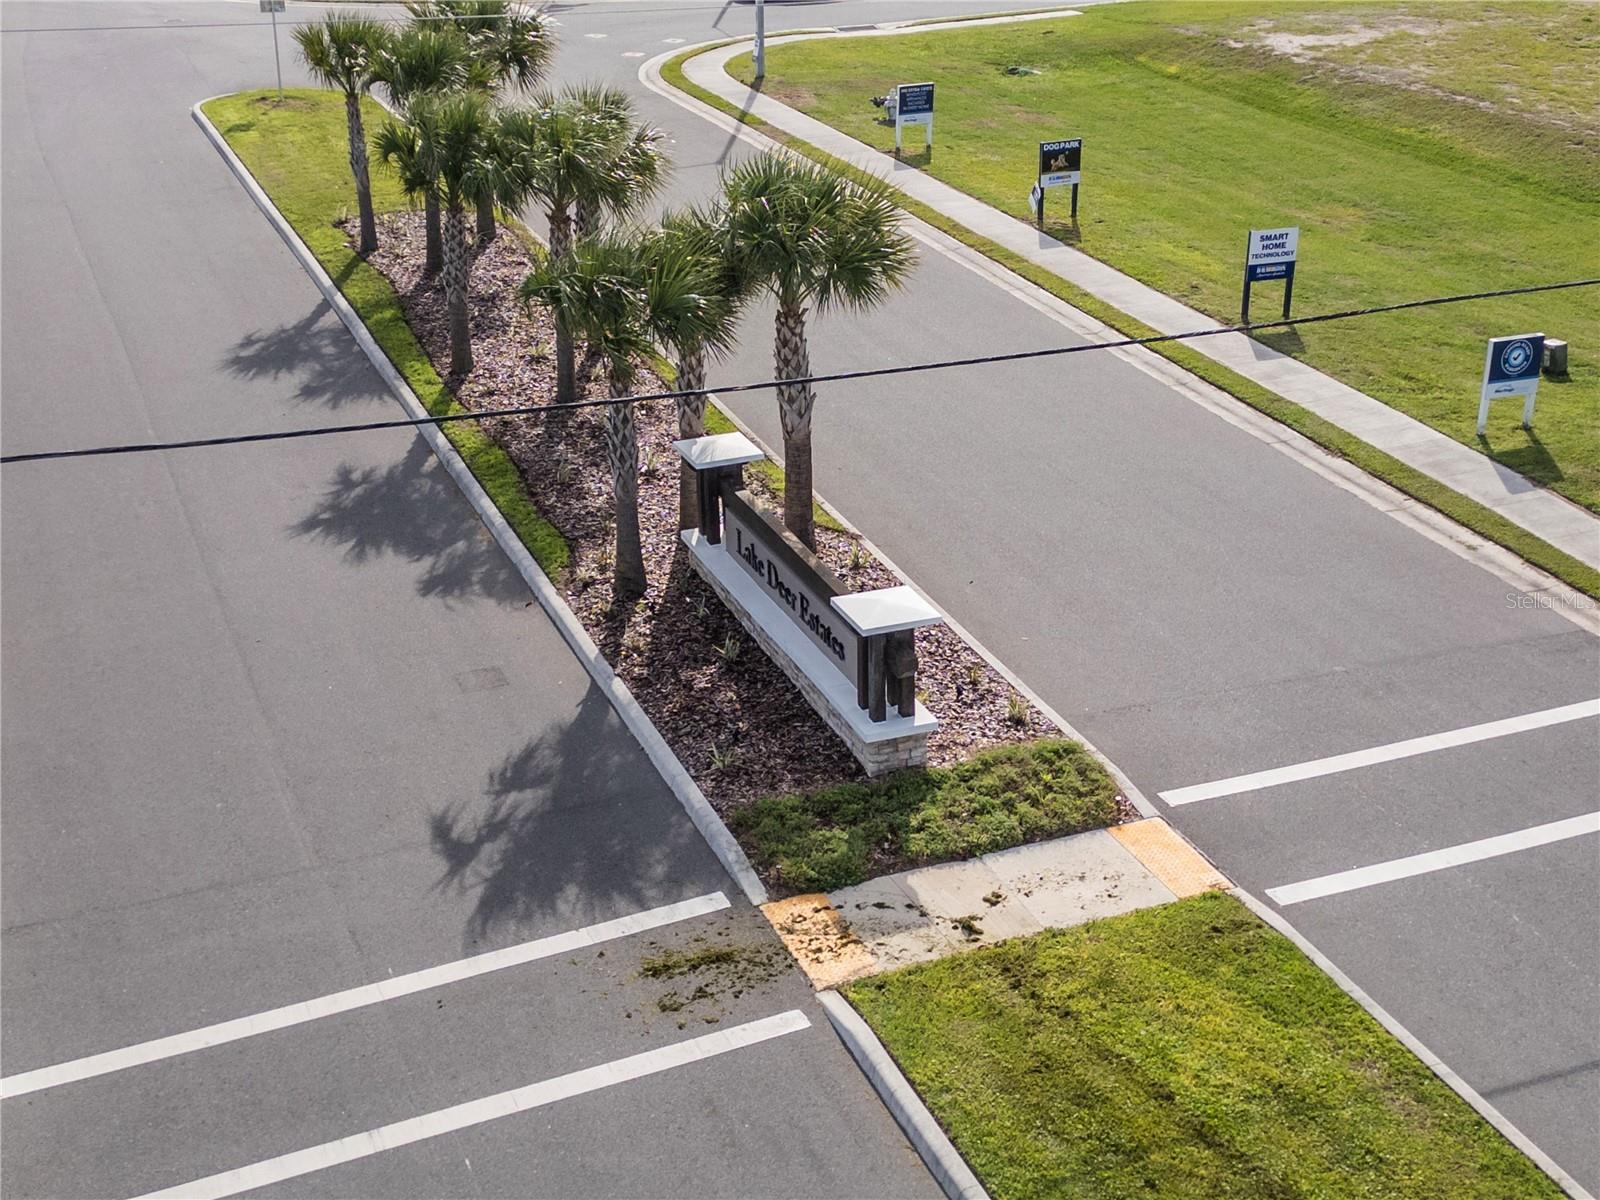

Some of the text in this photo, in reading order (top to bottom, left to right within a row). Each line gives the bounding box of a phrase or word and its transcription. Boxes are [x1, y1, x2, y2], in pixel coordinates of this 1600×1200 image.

[1043, 141, 1080, 151] DOG PARK
[1260, 233, 1289, 242] SMART
[1262, 242, 1287, 251] HOME
[1251, 250, 1295, 259] TECHNOLOGY
[736, 528, 845, 661] Lake Deer Estates
